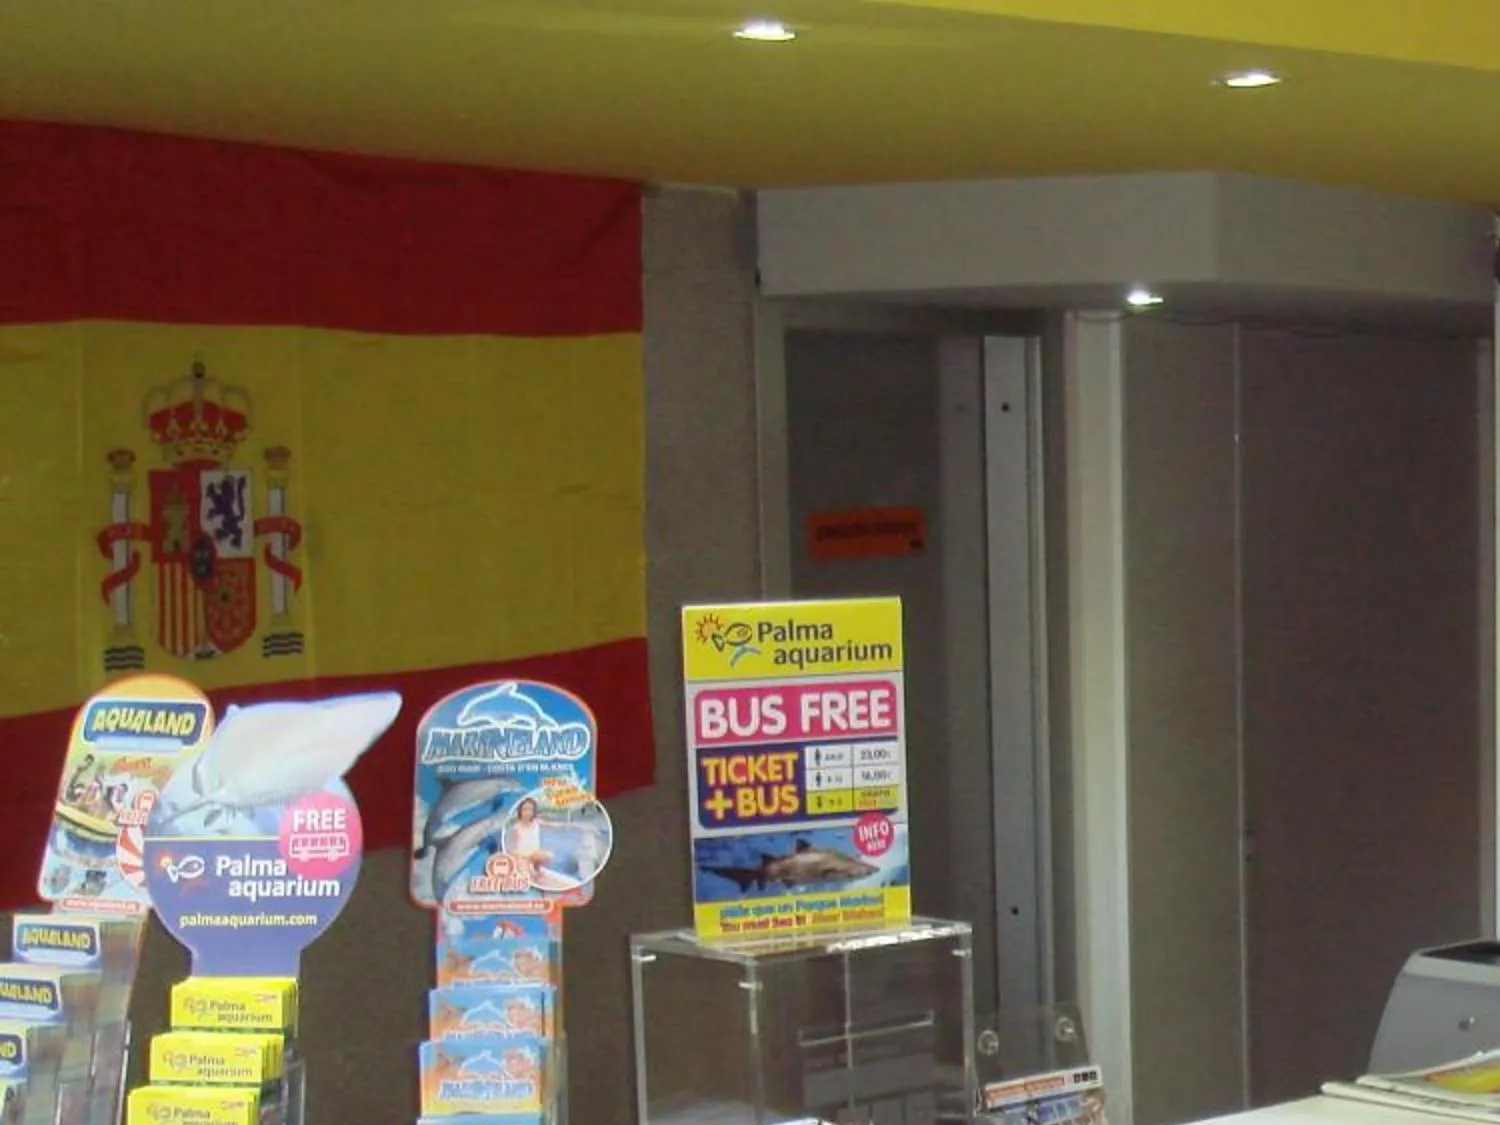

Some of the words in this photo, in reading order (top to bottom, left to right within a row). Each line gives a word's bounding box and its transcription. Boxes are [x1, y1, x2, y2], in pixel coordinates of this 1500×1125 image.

[757, 619, 833, 643] Palma
[774, 641, 893, 670] aquarium
[93, 708, 196, 737] AQUALAND
[702, 695, 787, 739] BUS
[801, 689, 892, 732] FREE
[703, 752, 799, 787] TICKET
[293, 809, 347, 831] FREE
[859, 820, 889, 839] INFO
[215, 854, 287, 876] Palma
[228, 875, 340, 902] aquarium
[179, 912, 318, 930] palmaaquarium.com
[23, 928, 91, 950] AQUALAND
[209, 1000, 246, 1011] Palma
[217, 1012, 273, 1024] aquarium
[189, 1054, 225, 1065] Palma
[197, 1067, 253, 1079] aquarium
[173, 1107, 210, 1118] Palma
